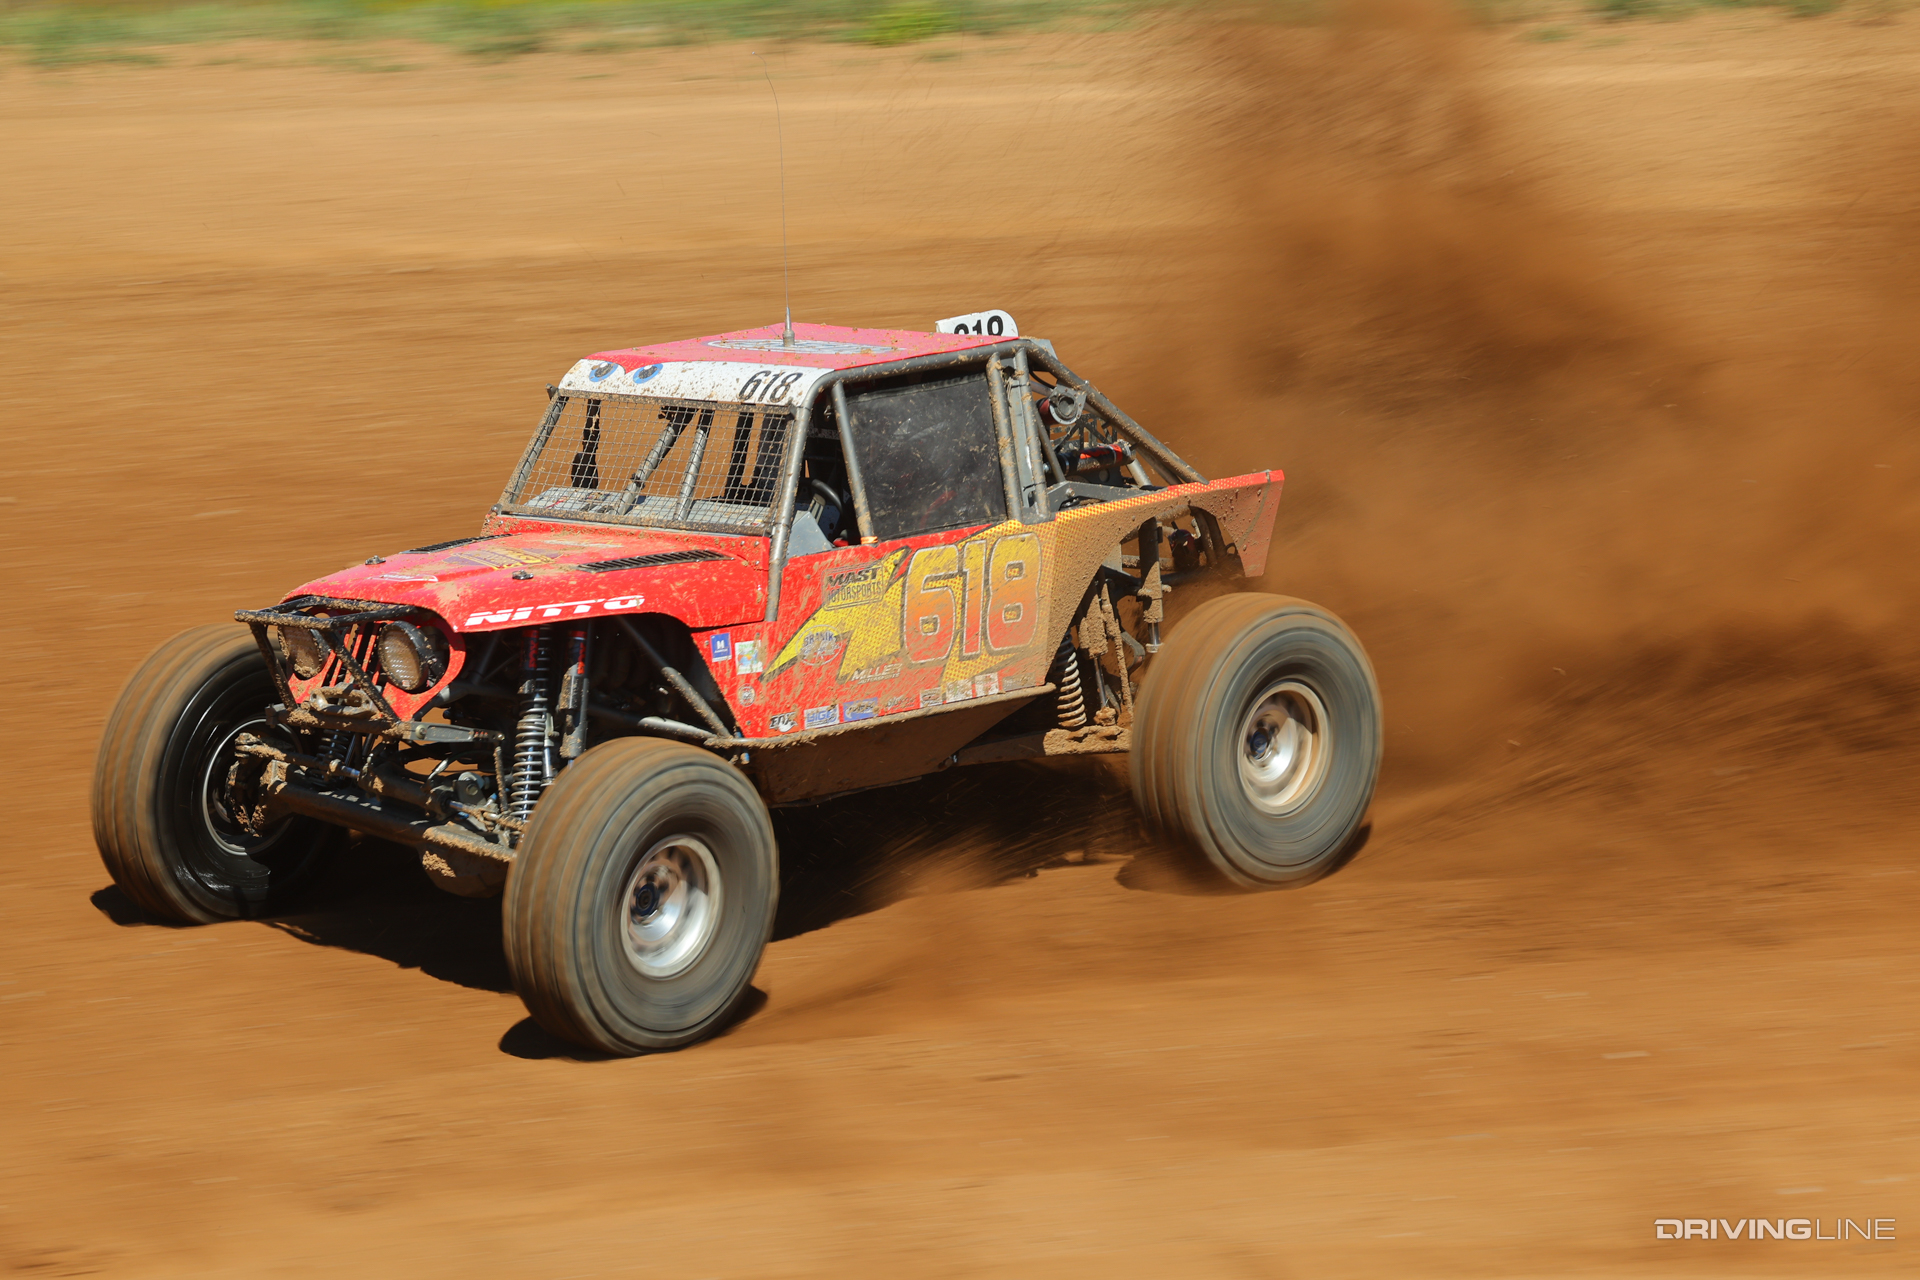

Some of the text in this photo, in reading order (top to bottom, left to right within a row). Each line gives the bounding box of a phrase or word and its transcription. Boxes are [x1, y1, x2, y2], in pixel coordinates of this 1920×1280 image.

[738, 370, 804, 404] 618
[825, 566, 881, 588] MAST
[827, 581, 882, 603] MOTORSPORTS
[904, 532, 1042, 663] 618
[464, 595, 645, 626] NITTO
[851, 663, 903, 682] MILLER
